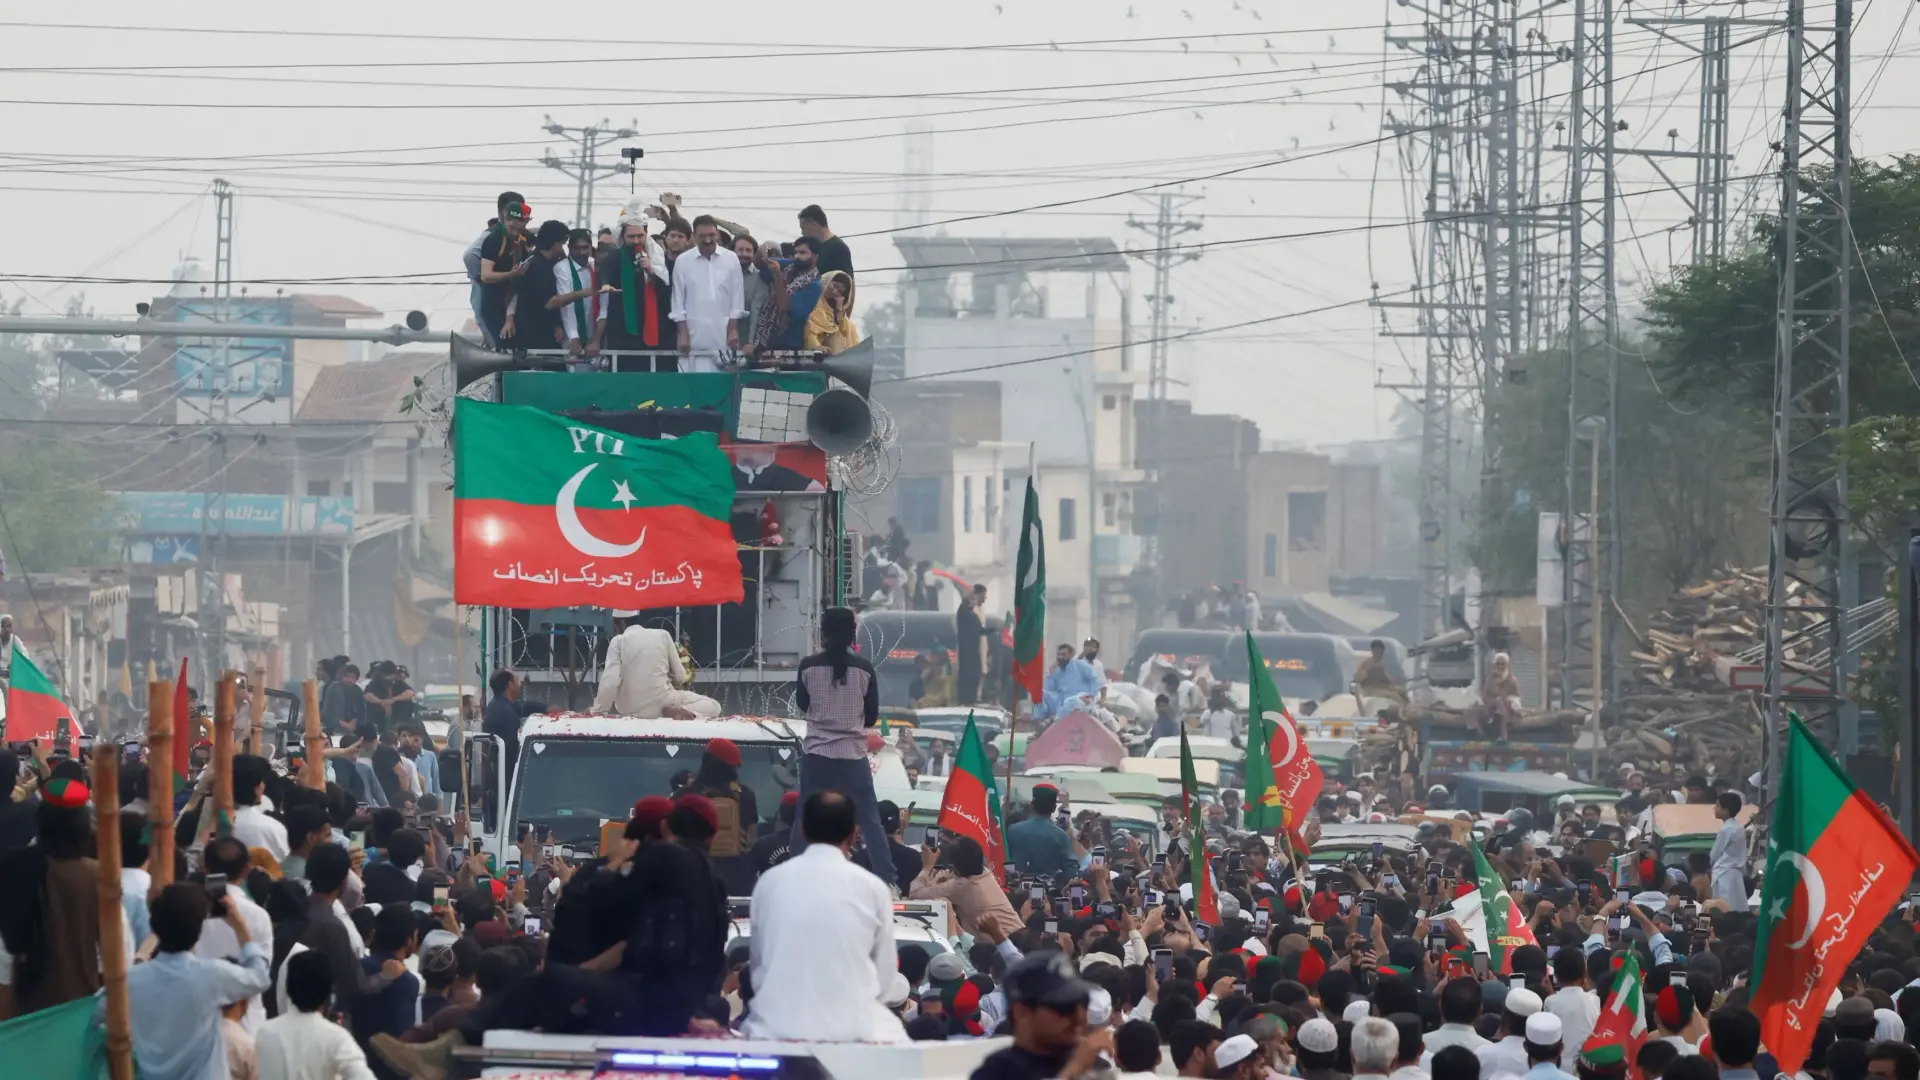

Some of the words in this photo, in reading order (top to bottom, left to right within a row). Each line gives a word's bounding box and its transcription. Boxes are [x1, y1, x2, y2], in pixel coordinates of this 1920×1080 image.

[566, 427, 624, 456] PTI
[493, 561, 559, 585] انصاف
[562, 562, 632, 588] تحریک
[635, 561, 702, 591] پاکستان
[945, 803, 979, 825] انصاف
